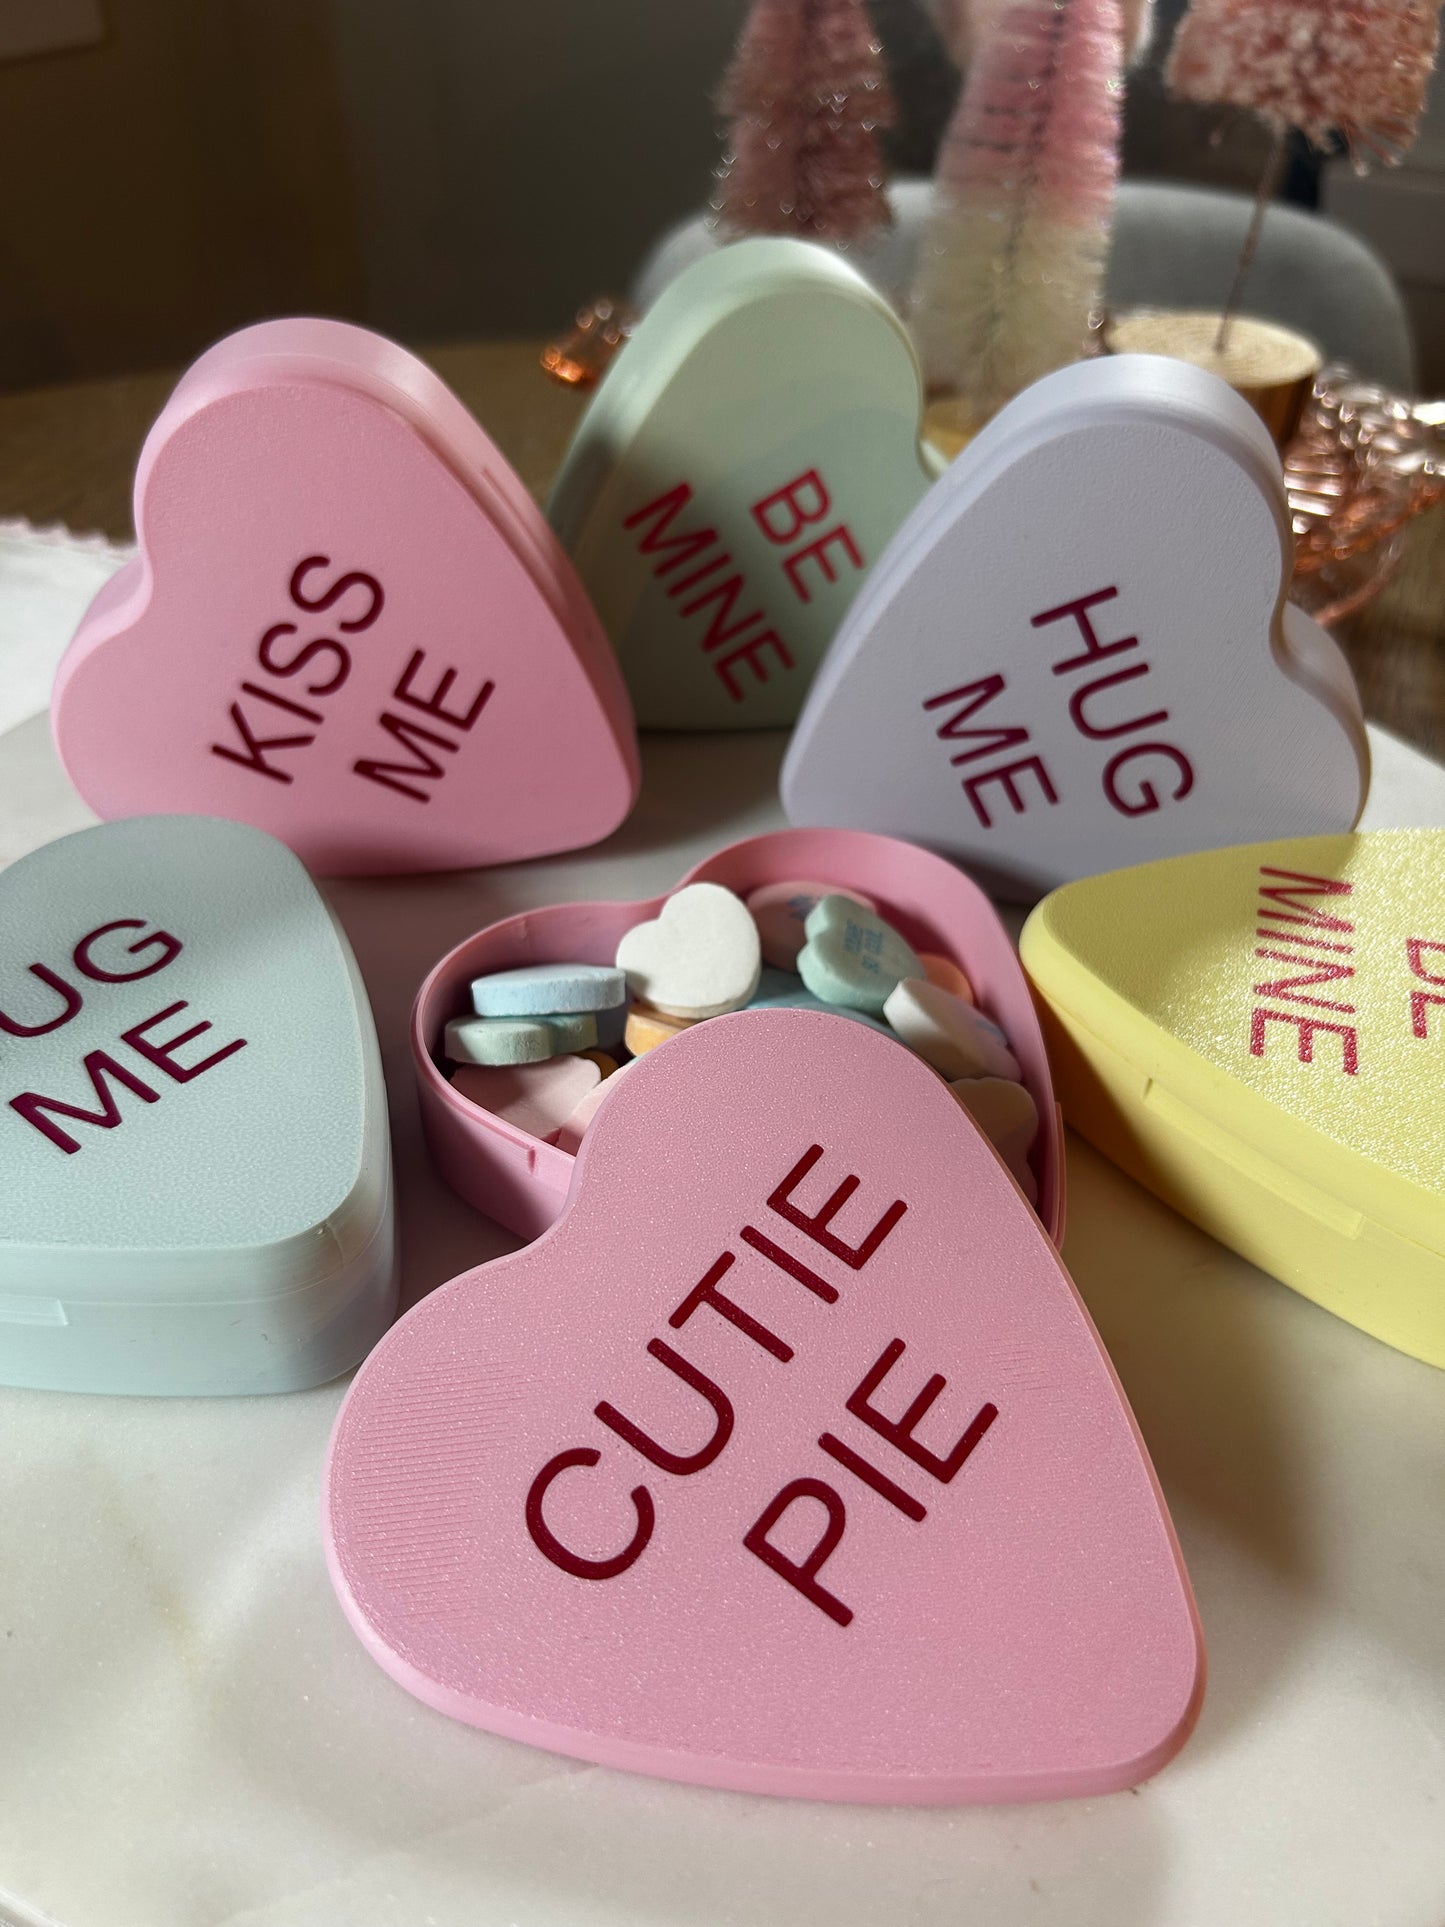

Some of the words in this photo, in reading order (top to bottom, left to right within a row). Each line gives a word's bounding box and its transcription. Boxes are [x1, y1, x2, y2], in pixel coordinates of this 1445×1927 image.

[622, 482, 796, 703] MINE
[751, 468, 865, 605] BE
[210, 555, 385, 786] KISS
[352, 648, 496, 804] ME
[922, 674, 1060, 830] ME
[1030, 585, 1194, 818] HUG
[0, 918, 184, 1038] UG
[8, 999, 248, 1155] ME
[1250, 866, 1358, 1077] MINE
[525, 1143, 909, 1580] CUTIE
[743, 1337, 999, 1628] PIE
